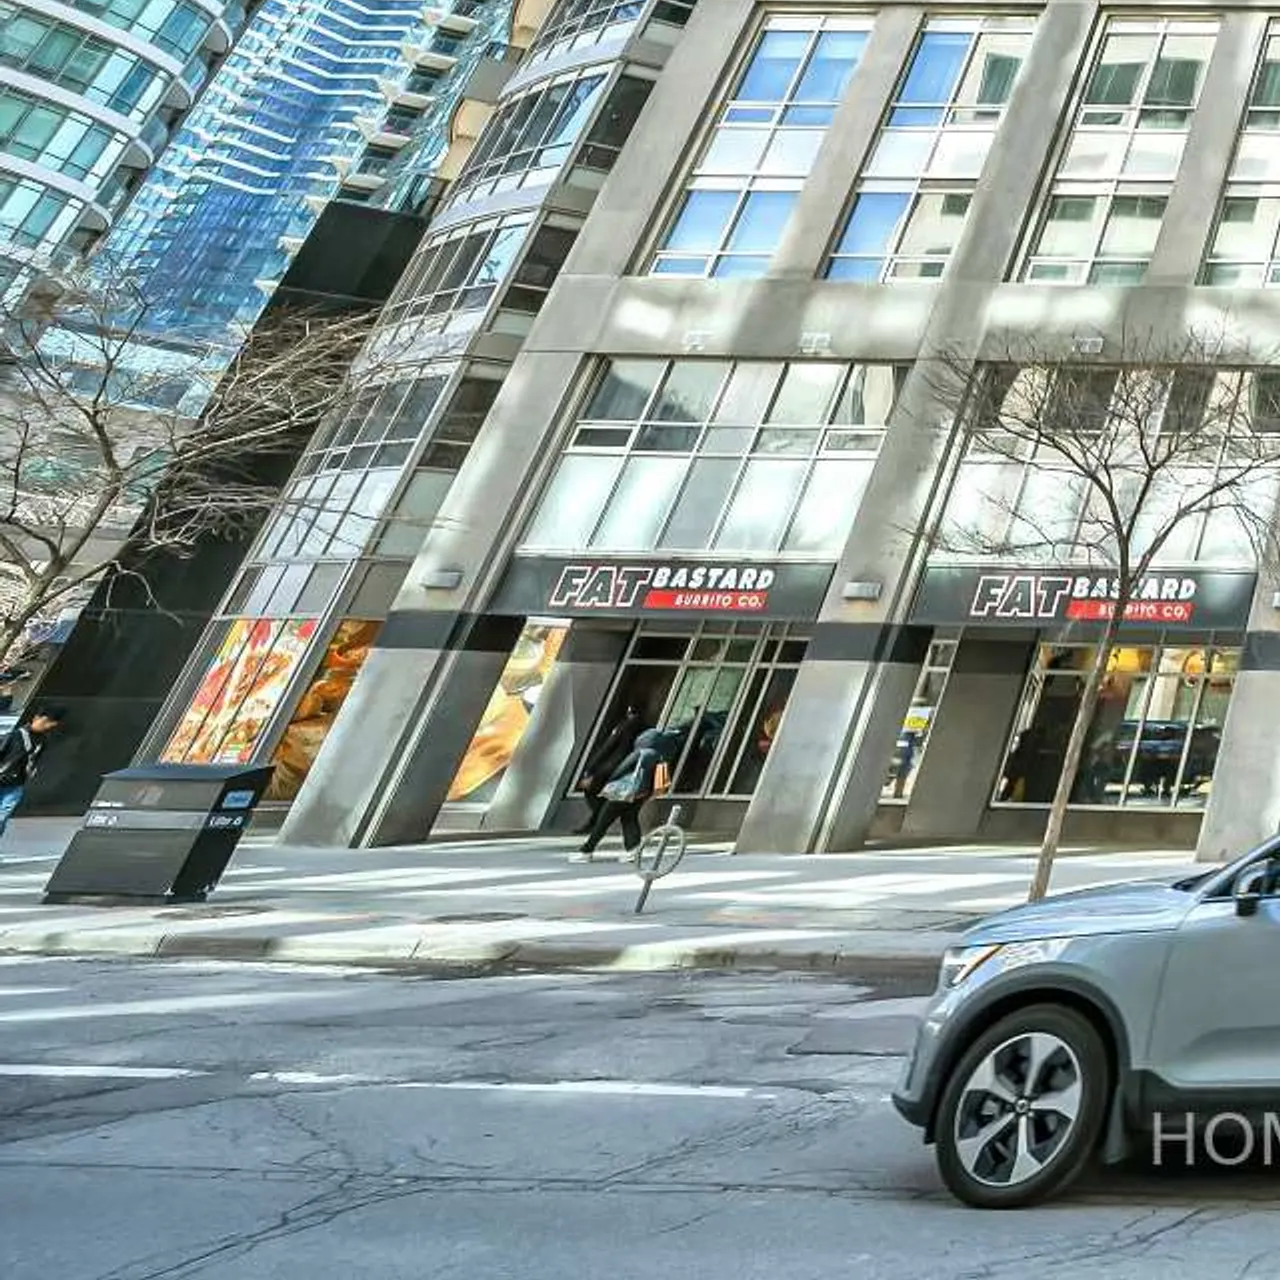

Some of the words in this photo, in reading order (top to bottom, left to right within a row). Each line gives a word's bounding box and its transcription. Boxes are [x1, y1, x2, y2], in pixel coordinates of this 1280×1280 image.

[549, 566, 653, 608] FAT
[651, 566, 775, 590] BASTARD
[969, 576, 1073, 617] FAT
[674, 594, 732, 607] BURRITO
[738, 595, 764, 608] CO.
[1098, 603, 1157, 617] BURITO
